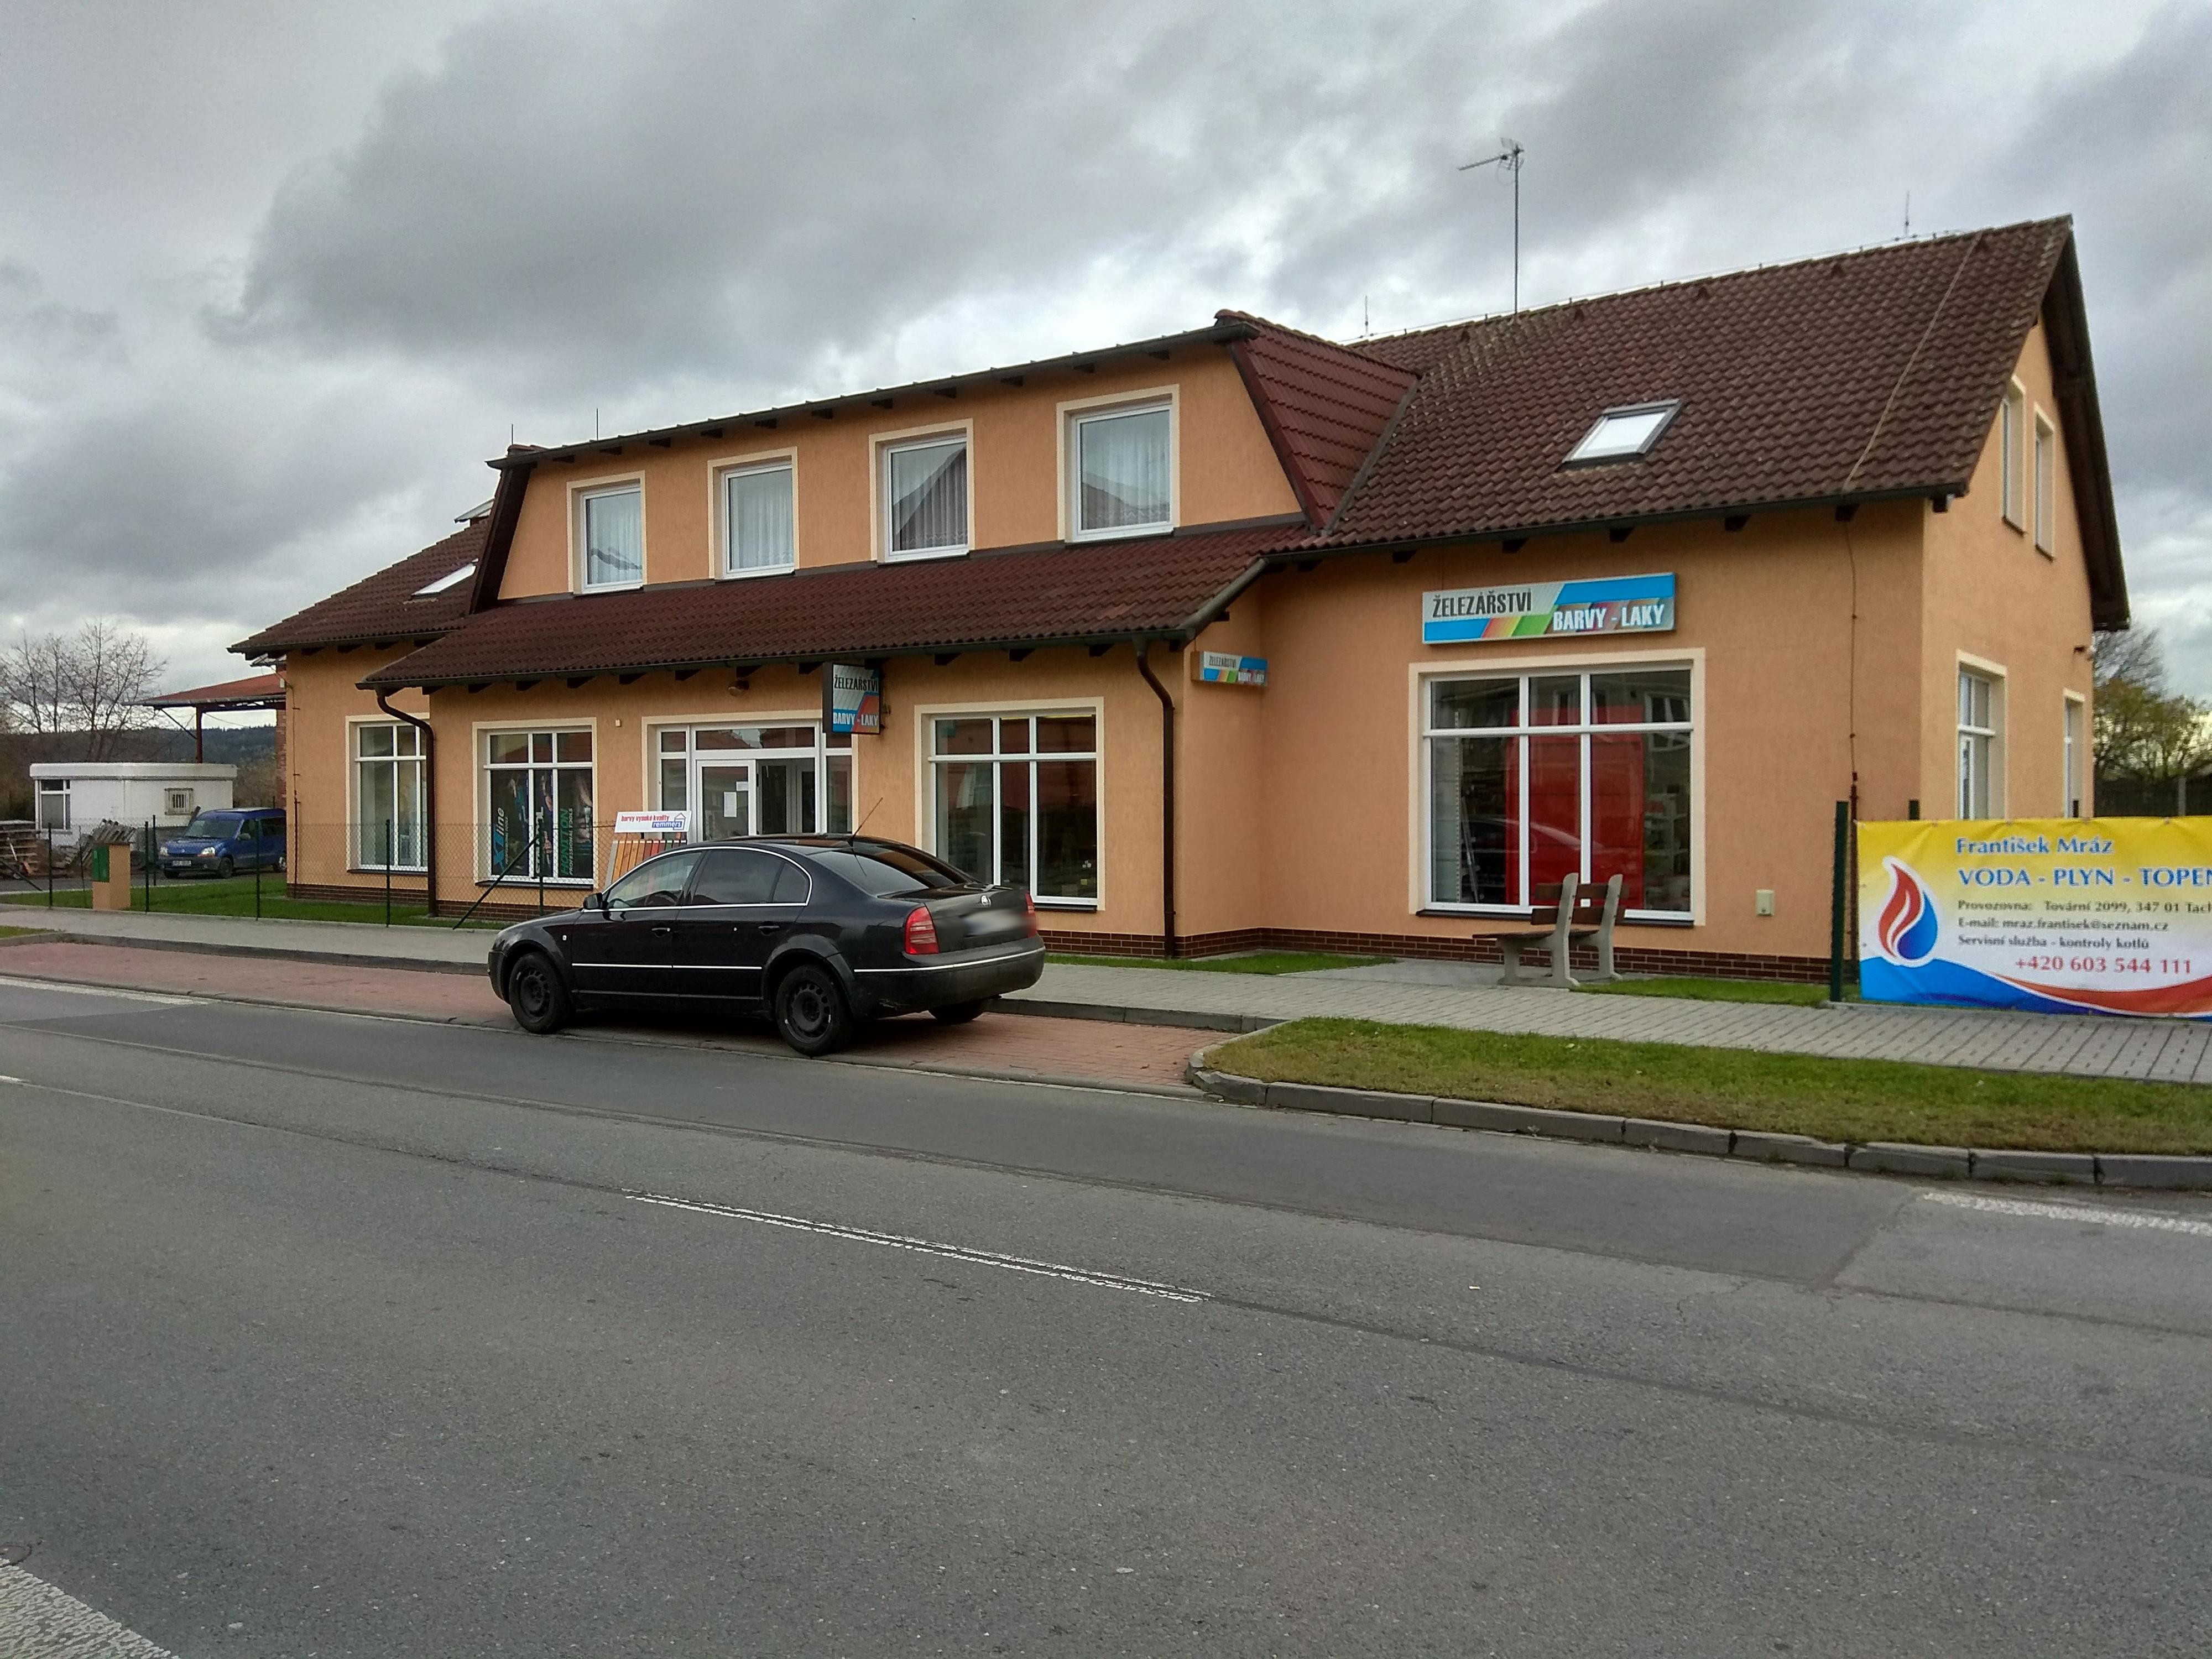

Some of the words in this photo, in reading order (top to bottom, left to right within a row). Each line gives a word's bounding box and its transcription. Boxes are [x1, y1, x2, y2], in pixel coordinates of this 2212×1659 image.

[1433, 588, 1532, 618] ŽELEZÁŘSTVÍ
[1553, 608, 1606, 631] BARVY
[1621, 605, 1665, 627] LAKY
[833, 712, 855, 725] BARVY
[861, 714, 878, 726] LAKY
[560, 808, 568, 875] HONITON
[1956, 836, 2050, 853] František
[2057, 837, 2113, 854] Mráz
[1958, 868, 2031, 886] VODA
[2054, 868, 2114, 886] PLYN
[1958, 900, 2032, 910] Provozovna:
[2044, 900, 2091, 910] Tovární
[2095, 901, 2131, 914] 2099,
[2136, 901, 2159, 912] 347
[2164, 901, 2179, 912] 01
[1958, 917, 1999, 928] E-mail:
[2002, 917, 2169, 931] mraz.frantisek@seznam.cz
[1958, 935, 2005, 946] Servisní
[2008, 935, 2047, 946] služba
[2059, 936, 2111, 950] kontroly
[2116, 937, 2150, 949] kotlů
[2015, 956, 2064, 971] +420
[2070, 956, 2106, 973] 603
[2115, 957, 2151, 973] 544
[2161, 959, 2191, 974] 111
